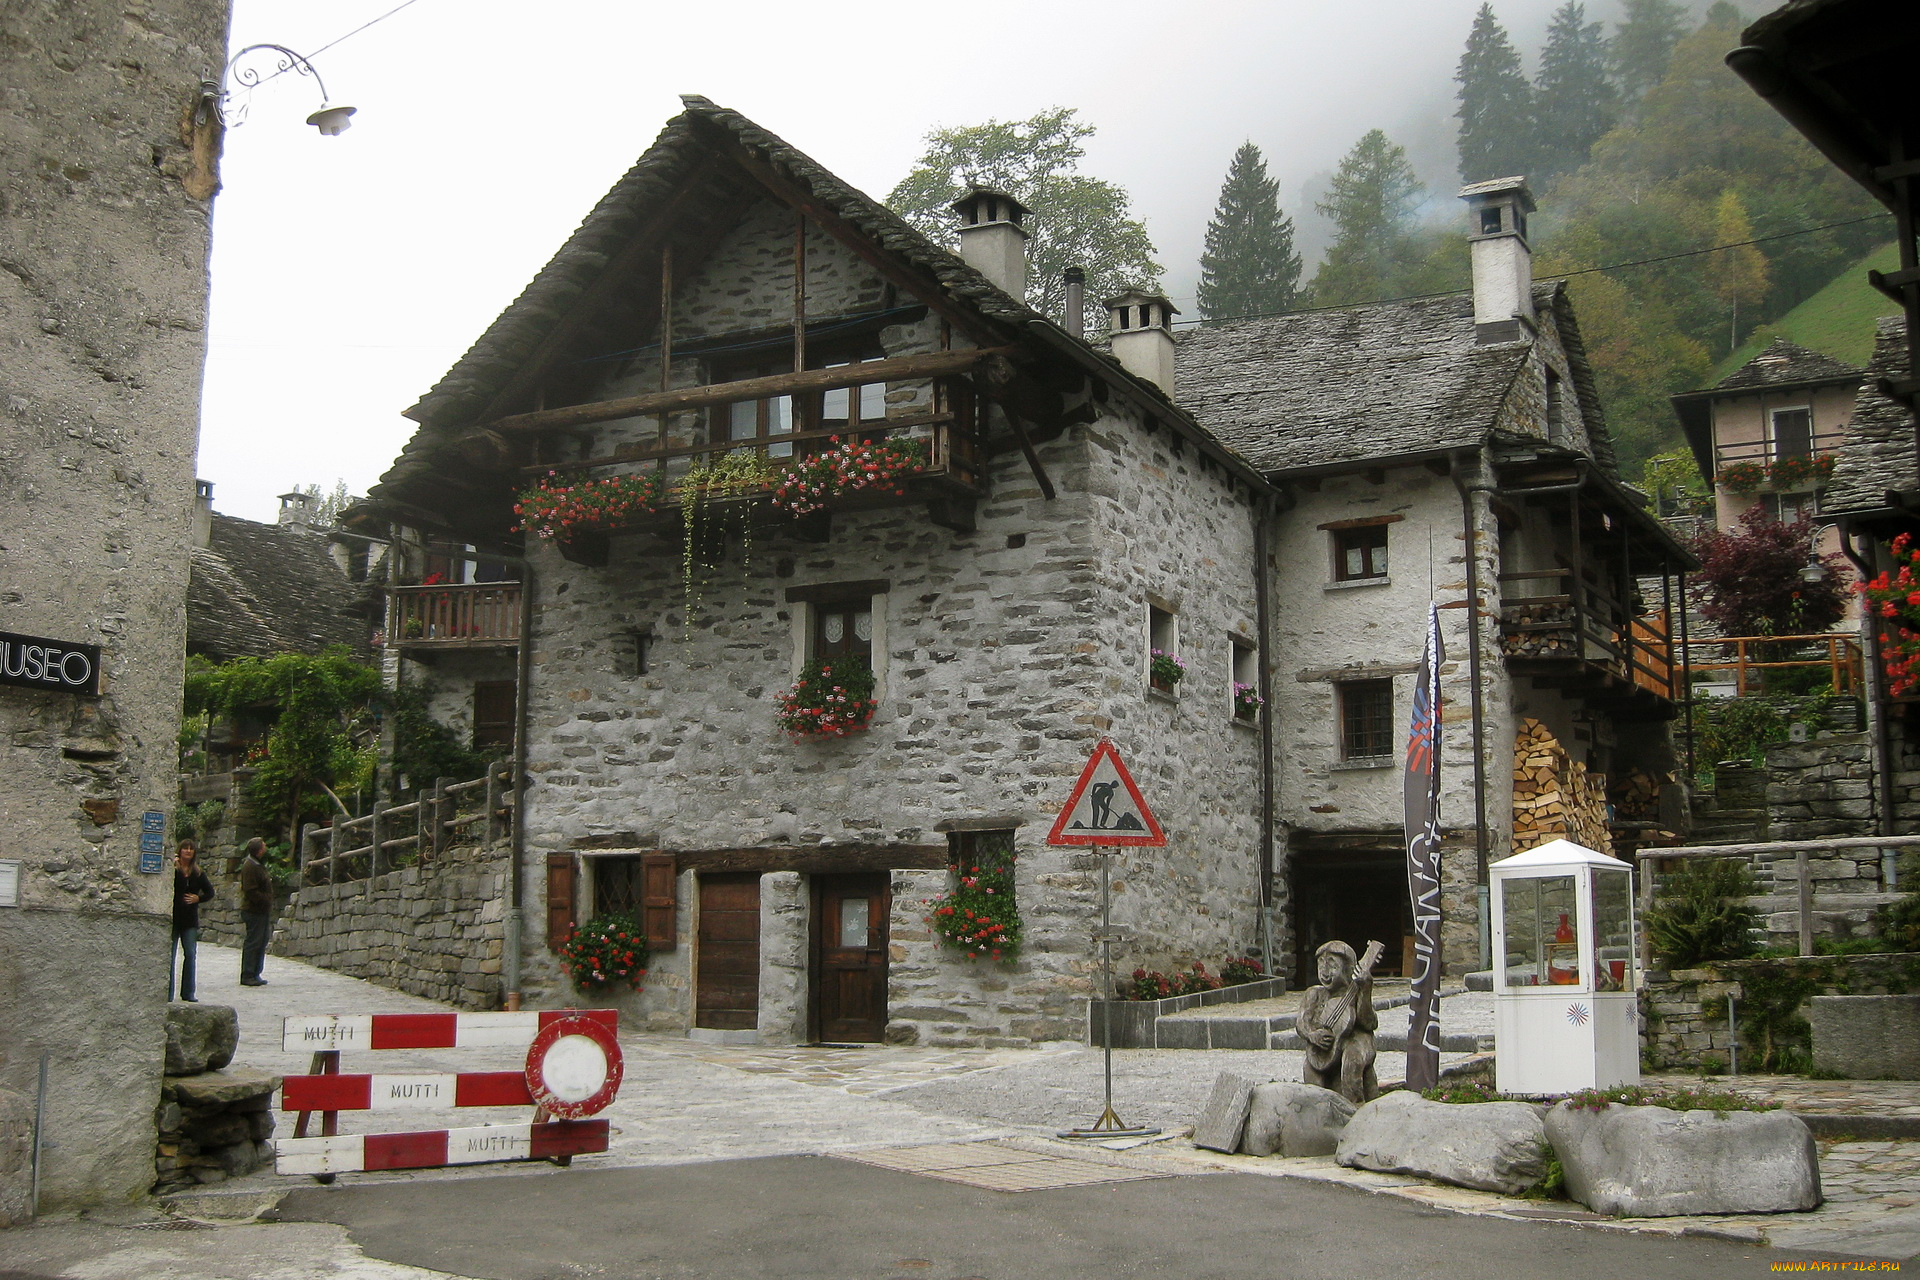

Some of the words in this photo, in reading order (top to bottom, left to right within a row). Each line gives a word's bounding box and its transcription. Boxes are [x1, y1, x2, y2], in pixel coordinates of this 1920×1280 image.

[0, 640, 91, 685] USEO
[304, 1025, 354, 1041] MUTTI
[391, 1084, 439, 1098] MUTTI
[468, 1135, 514, 1152] MUTTI
